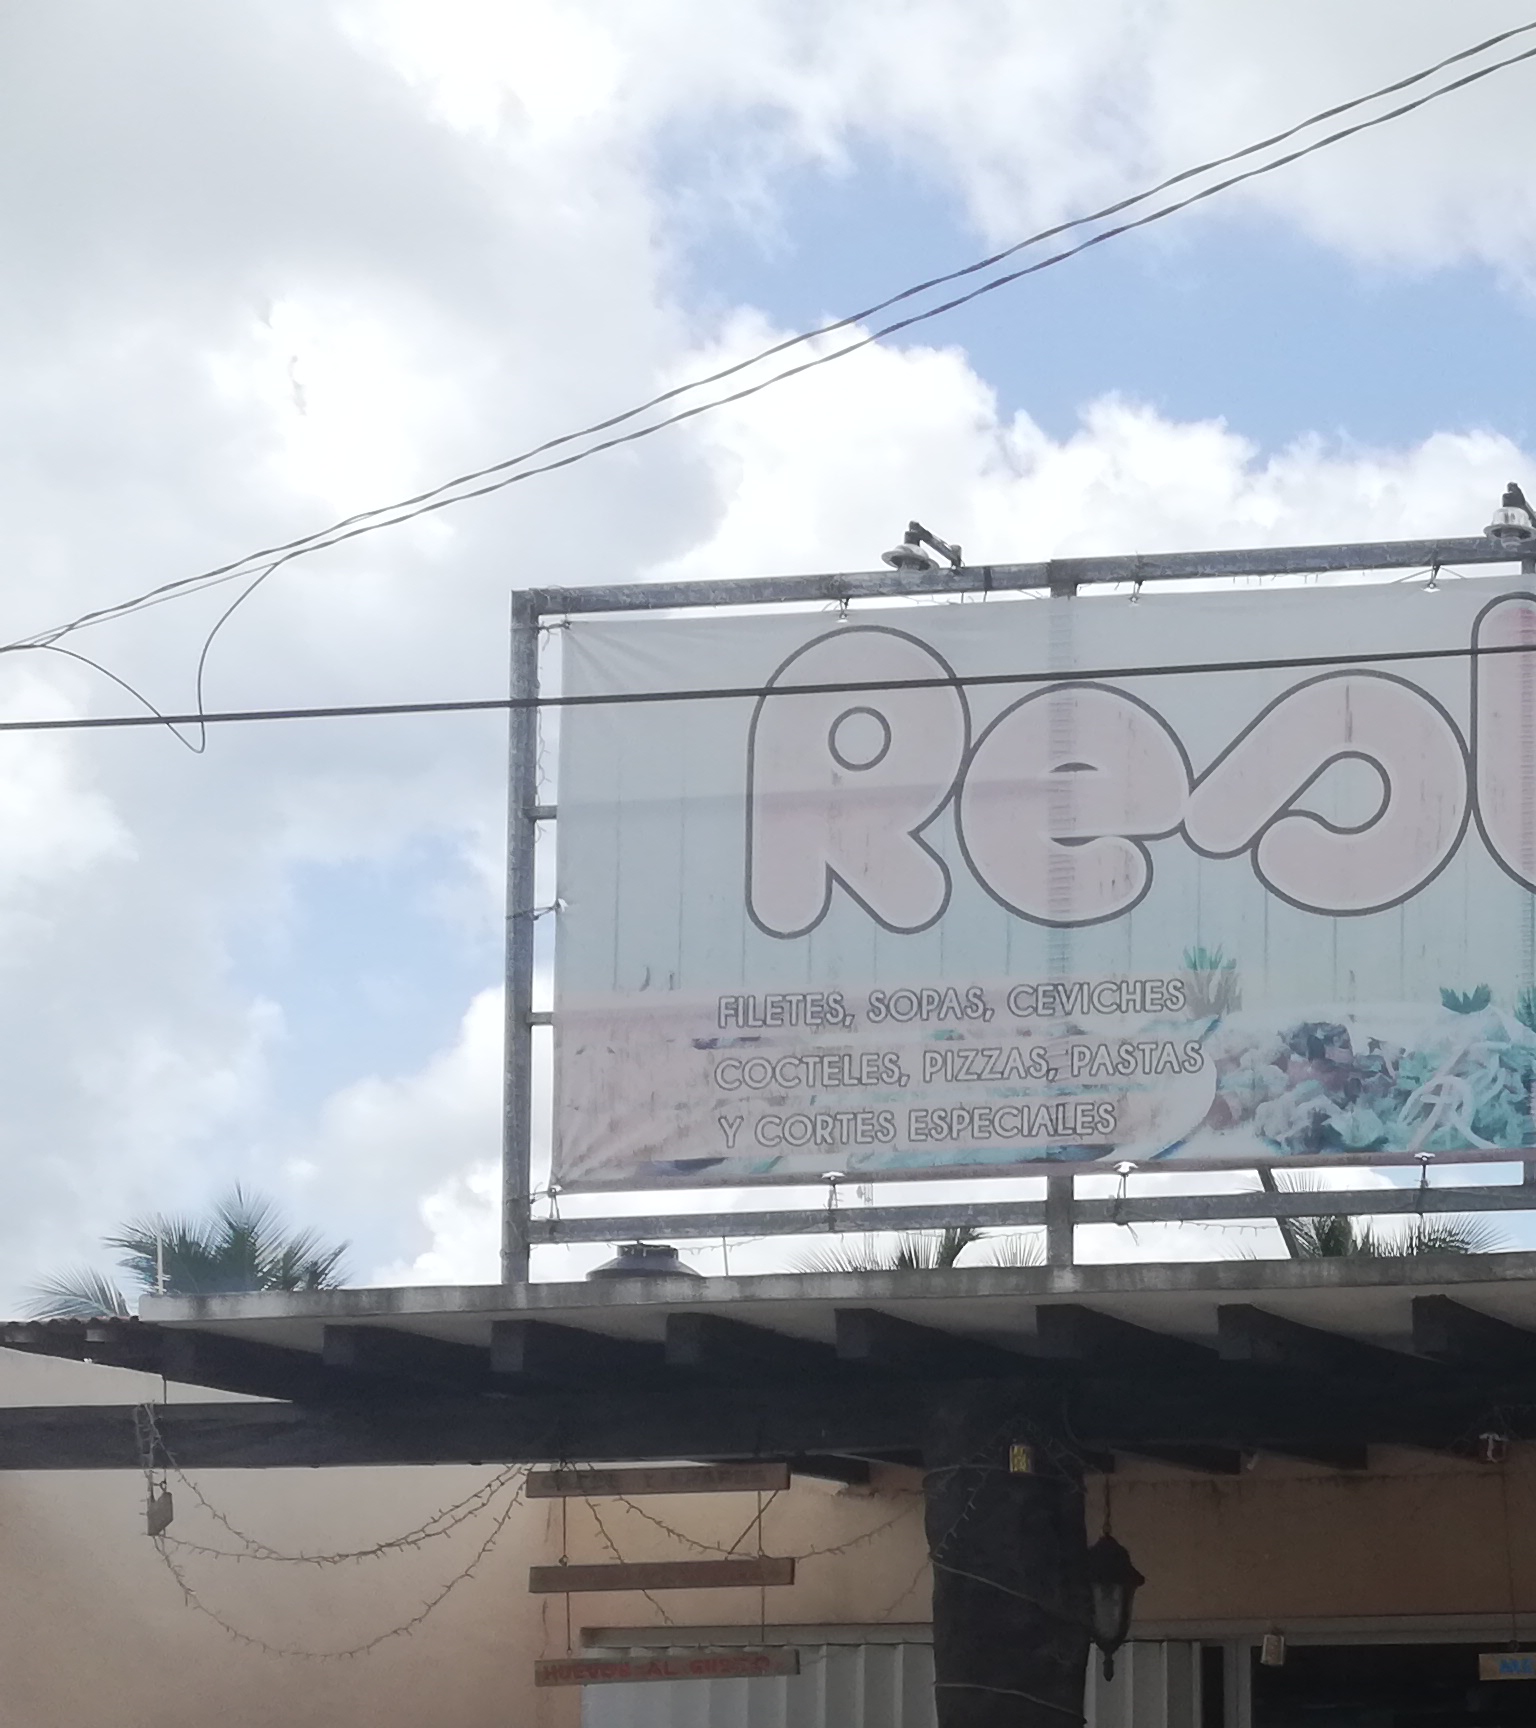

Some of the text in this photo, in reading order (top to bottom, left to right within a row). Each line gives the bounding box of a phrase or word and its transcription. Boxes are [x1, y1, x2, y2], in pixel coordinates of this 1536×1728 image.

[717, 978, 1187, 1028] FILETES, SOPAS, CEVICHES
[714, 1040, 1205, 1092] COCTELES, PIZZAS, PASTAS
[718, 1101, 1117, 1149] Y CORTES ESPECIALES
